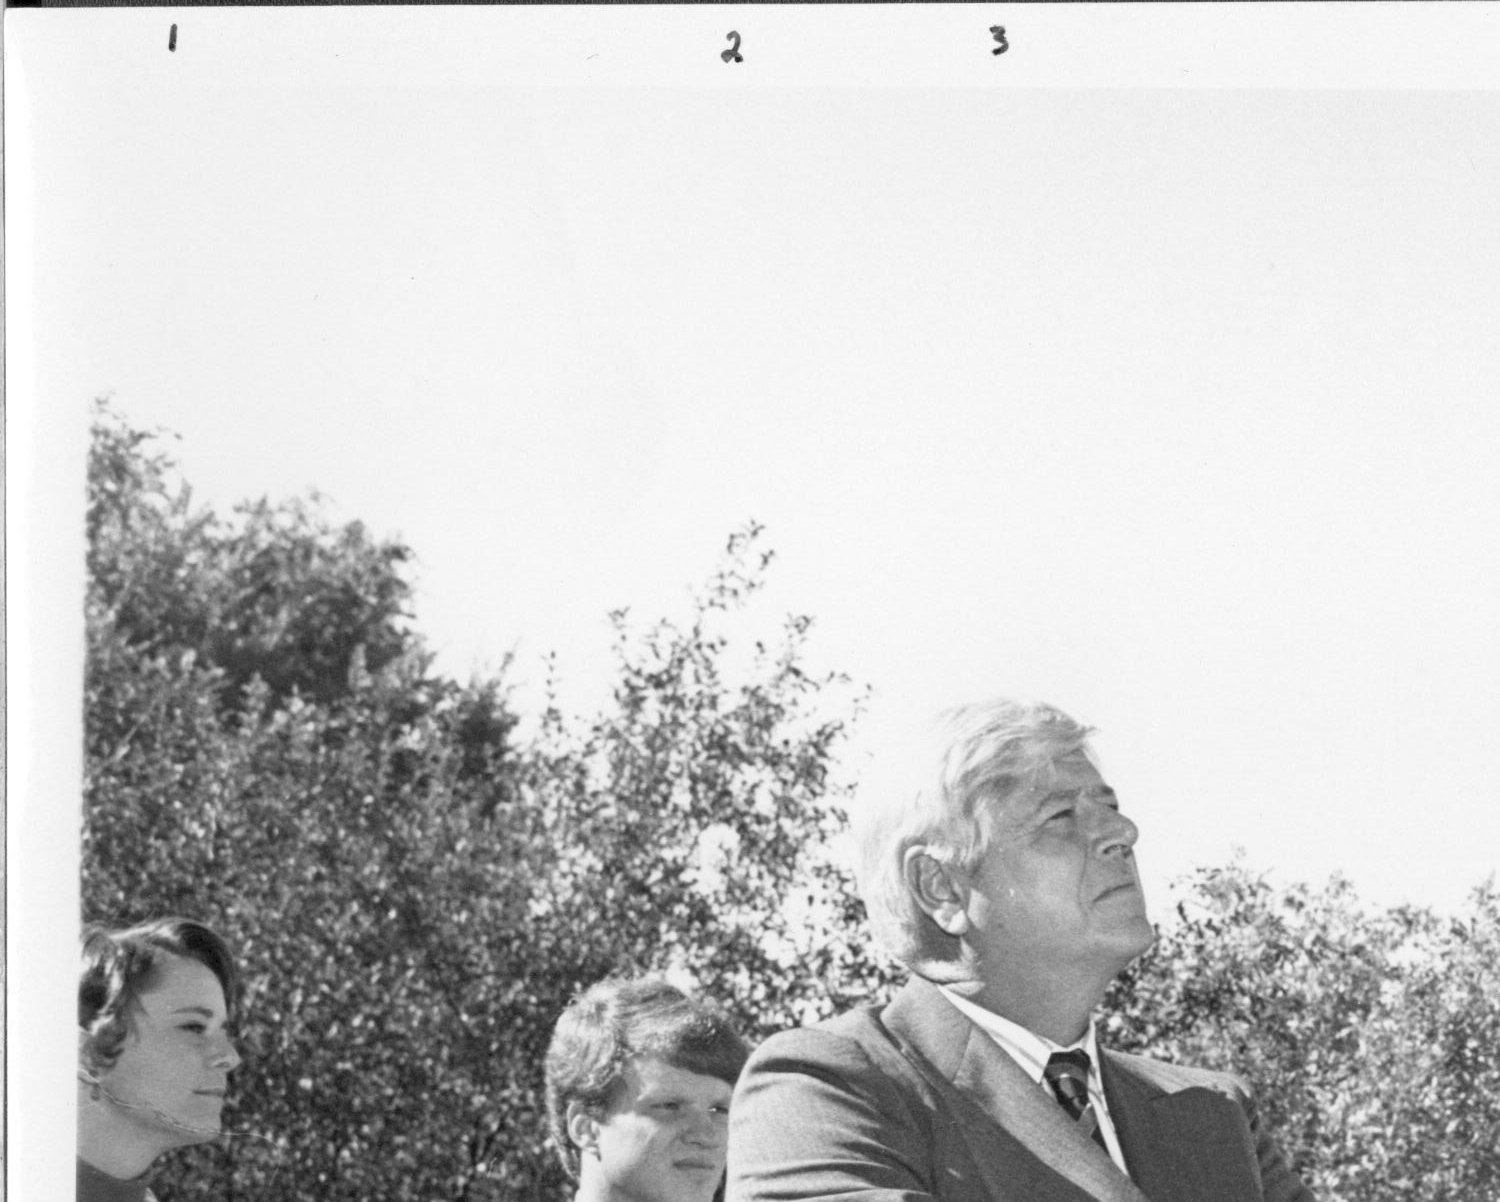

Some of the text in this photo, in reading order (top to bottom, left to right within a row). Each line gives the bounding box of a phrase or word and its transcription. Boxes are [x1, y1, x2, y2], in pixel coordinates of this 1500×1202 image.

[168, 24, 178, 53] 1
[720, 30, 744, 64] 2
[989, 25, 1009, 56] 3
